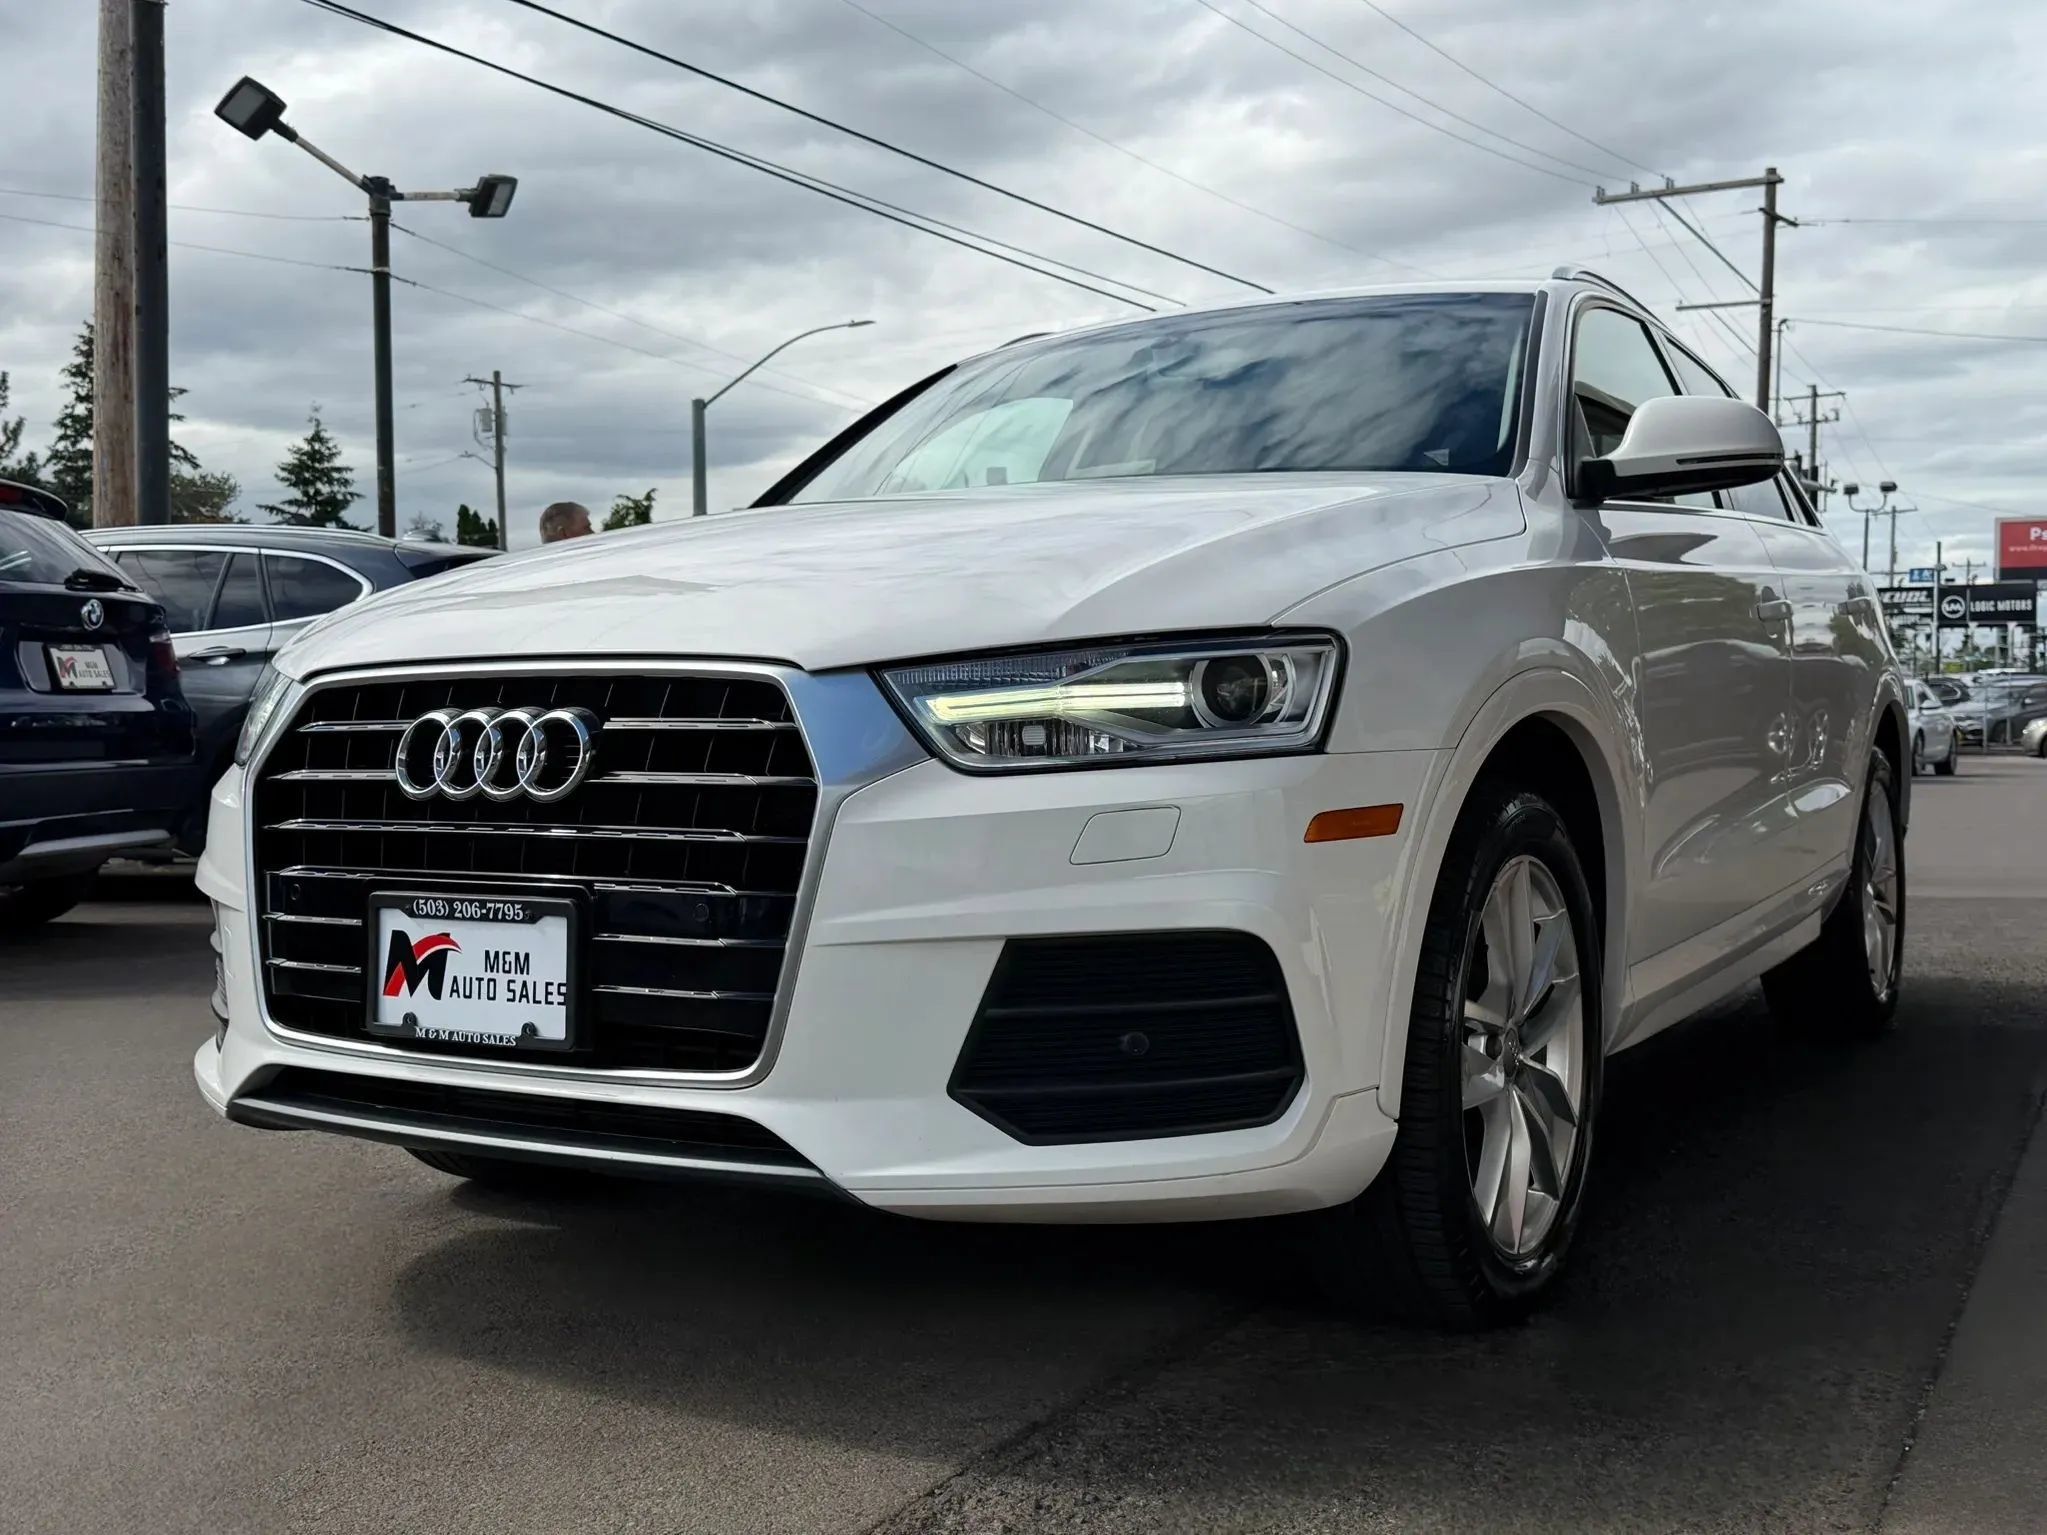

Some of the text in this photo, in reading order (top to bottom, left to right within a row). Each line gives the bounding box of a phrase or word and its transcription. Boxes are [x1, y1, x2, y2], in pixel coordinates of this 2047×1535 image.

[1970, 599, 2032, 612] LOGIC MOTORS
[413, 899, 523, 920] (503) 206-7795
[449, 975, 566, 1006] AUTO SALES
[415, 1027, 517, 1046] M & M AUTO SALES
